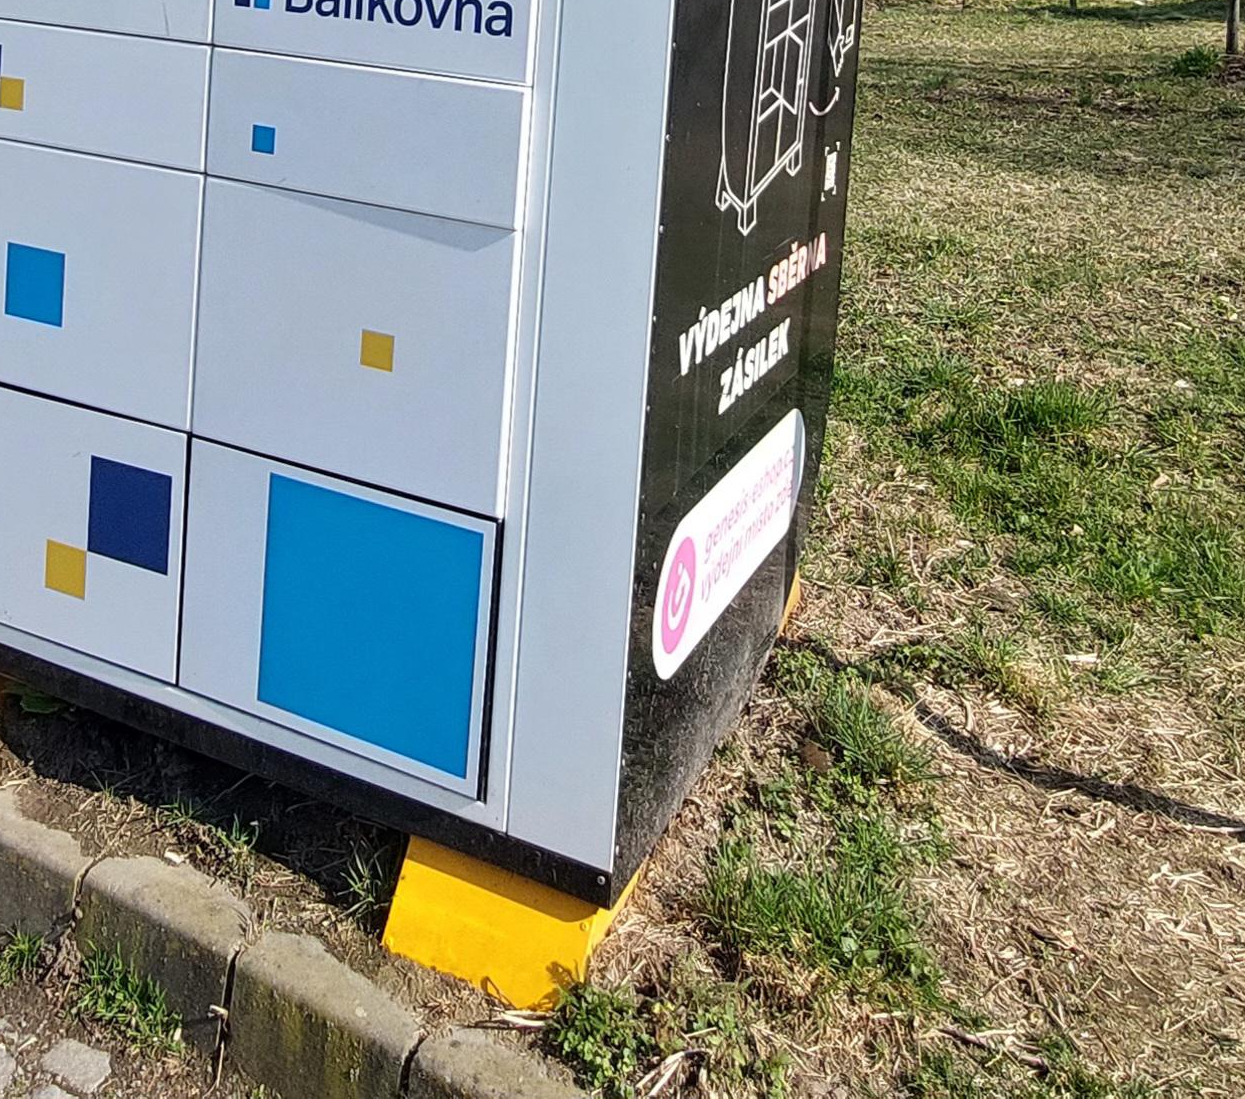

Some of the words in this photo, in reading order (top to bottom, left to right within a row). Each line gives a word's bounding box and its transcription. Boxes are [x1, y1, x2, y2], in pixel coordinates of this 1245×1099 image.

[679, 275, 765, 377] VÝDEJNA
[767, 232, 827, 305] SBĚRNA
[718, 317, 791, 416] ZÁSILEK
